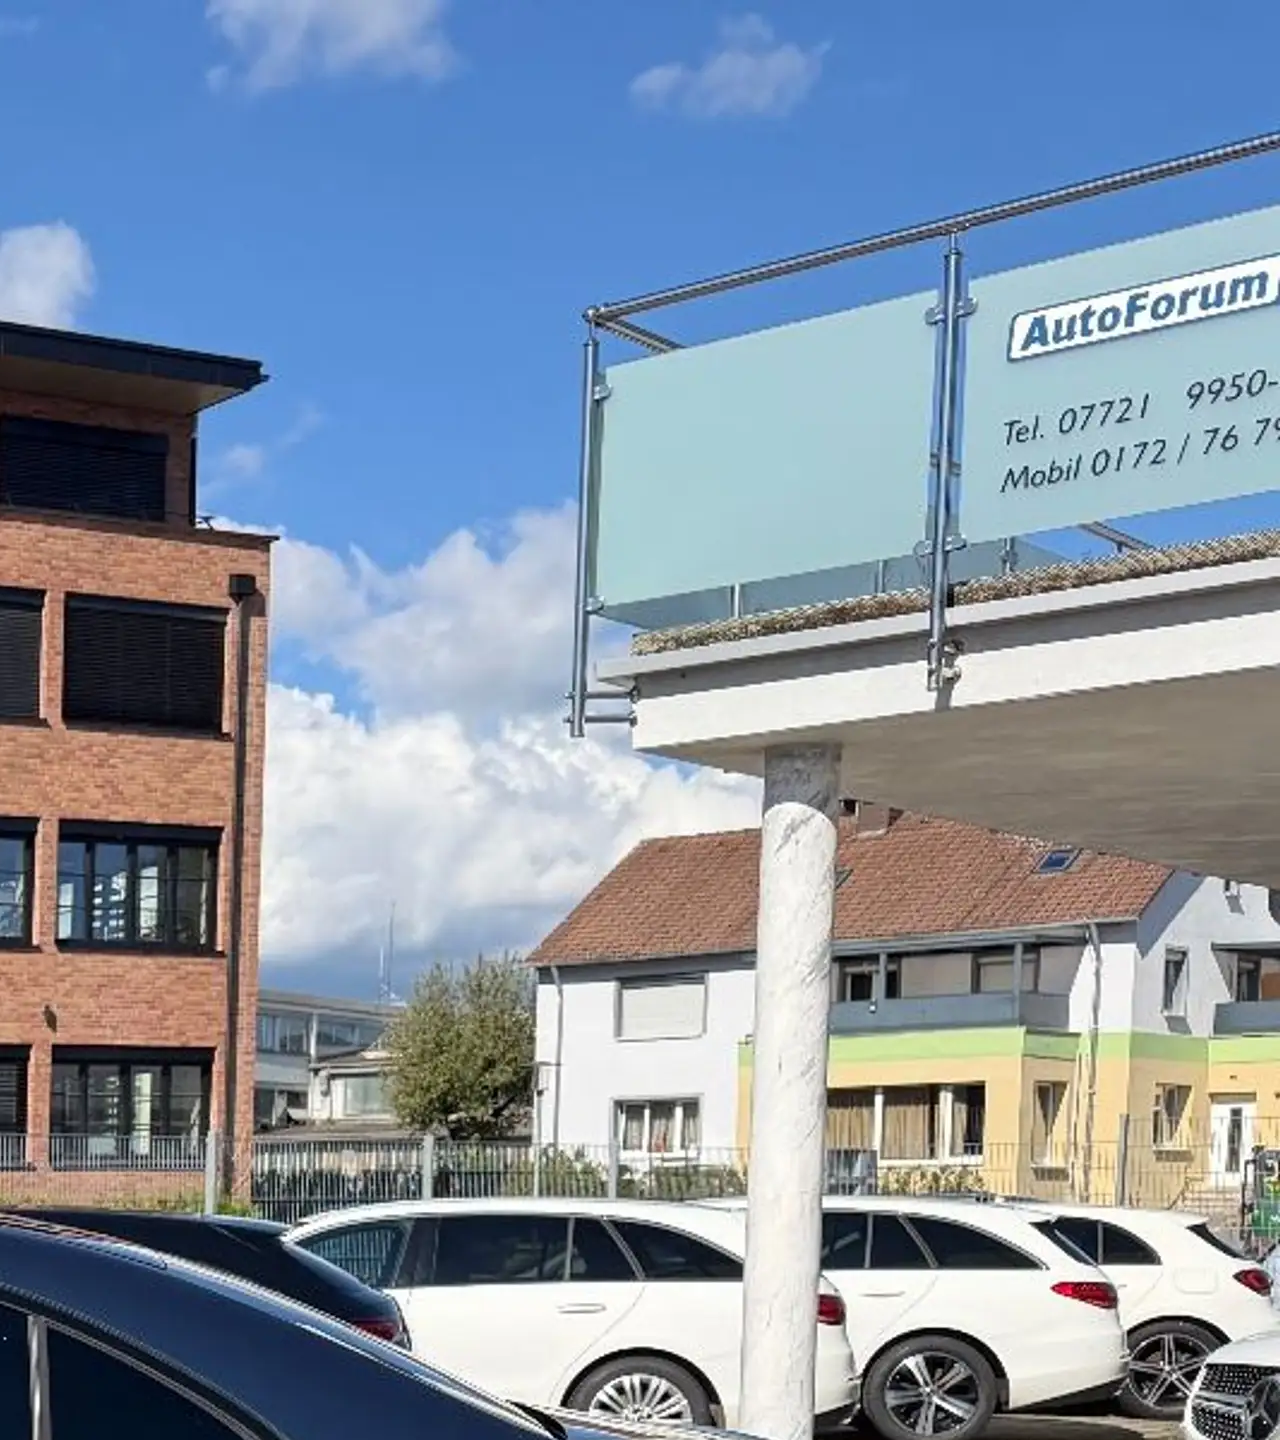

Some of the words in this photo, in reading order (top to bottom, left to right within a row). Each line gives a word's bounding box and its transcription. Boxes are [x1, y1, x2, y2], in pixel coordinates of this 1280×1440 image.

[1020, 270, 1269, 352] AutoForum
[1004, 415, 1044, 446] Tel.
[1058, 392, 1150, 434] 07721
[1186, 369, 1279, 410] 9950-
[1000, 453, 1082, 493] Mobil
[1090, 438, 1167, 477] 0172
[1176, 432, 1191, 465] /
[1203, 424, 1239, 455] 76
